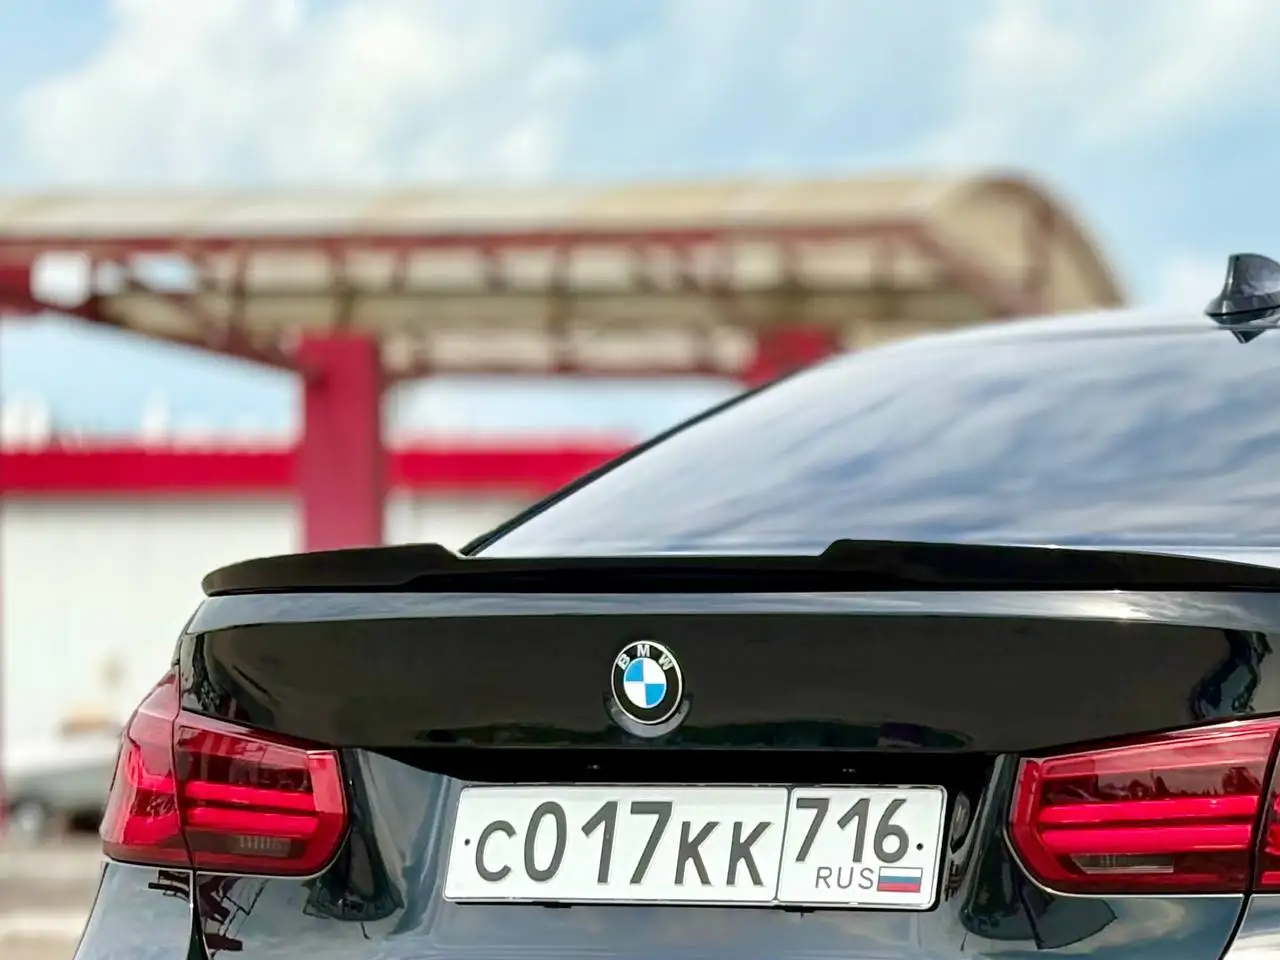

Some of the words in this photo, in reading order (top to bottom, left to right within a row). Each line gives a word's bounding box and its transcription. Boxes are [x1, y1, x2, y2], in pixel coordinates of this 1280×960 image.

[617, 644, 674, 671] BMW
[795, 798, 910, 864] 716
[815, 867, 874, 890] RUS
